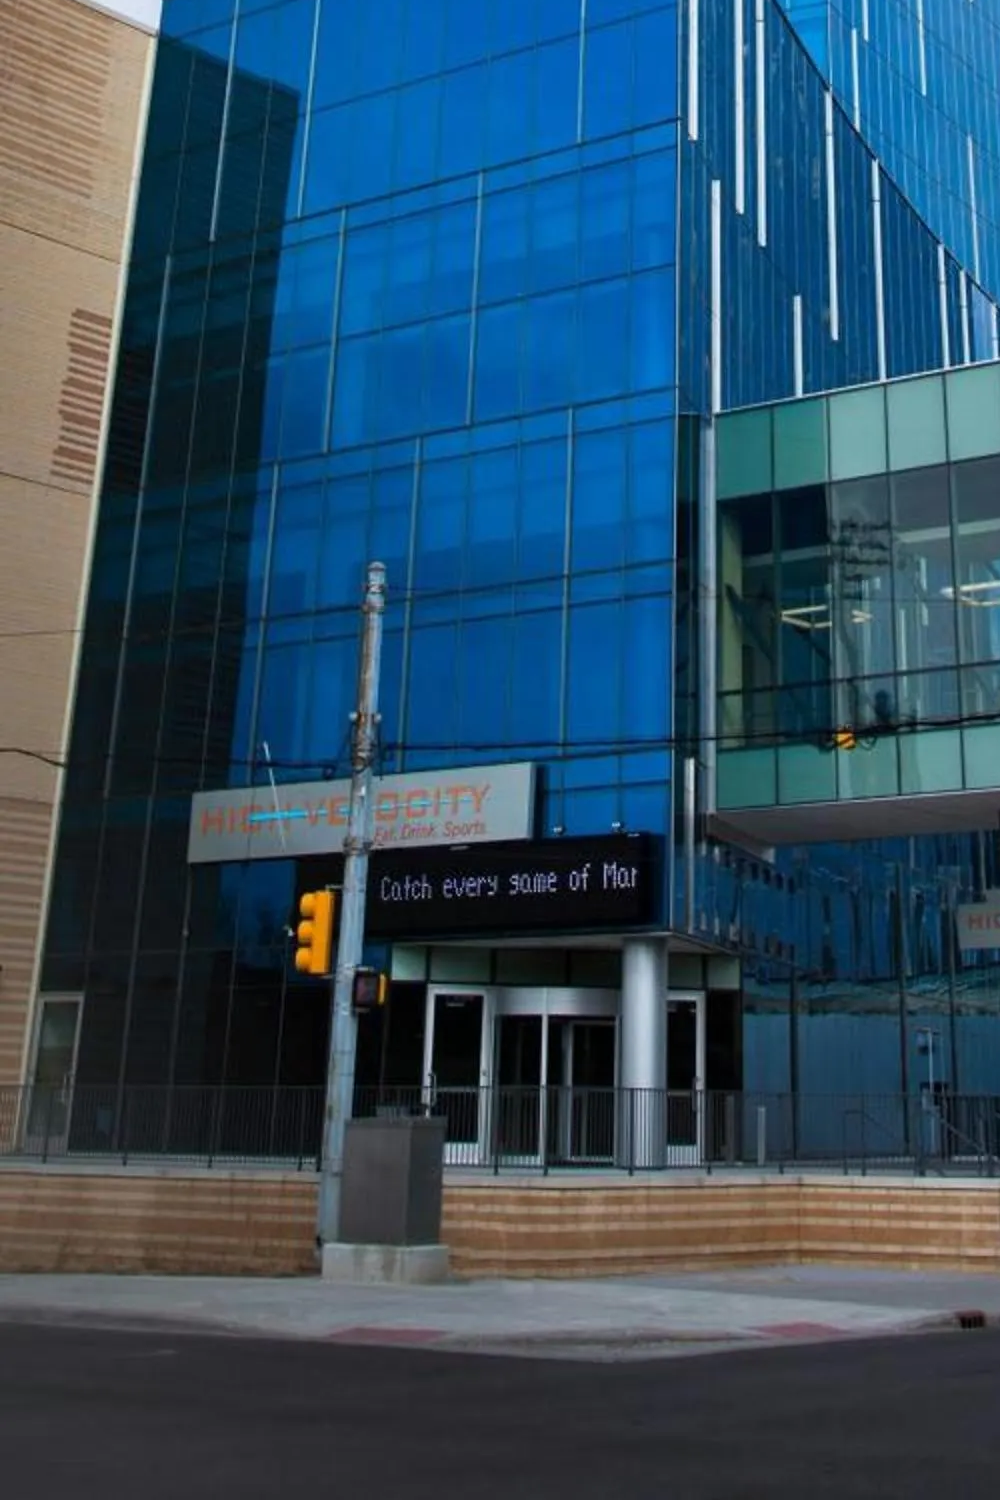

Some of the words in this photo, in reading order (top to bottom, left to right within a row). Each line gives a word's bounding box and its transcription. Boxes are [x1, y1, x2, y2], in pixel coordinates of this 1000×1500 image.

[200, 801, 291, 836] HIGH
[305, 784, 491, 826] VEOCITY
[380, 874, 433, 901] Catch
[442, 874, 498, 898] every
[508, 871, 558, 895] game
[568, 862, 591, 892] of
[602, 861, 638, 890] Mar
